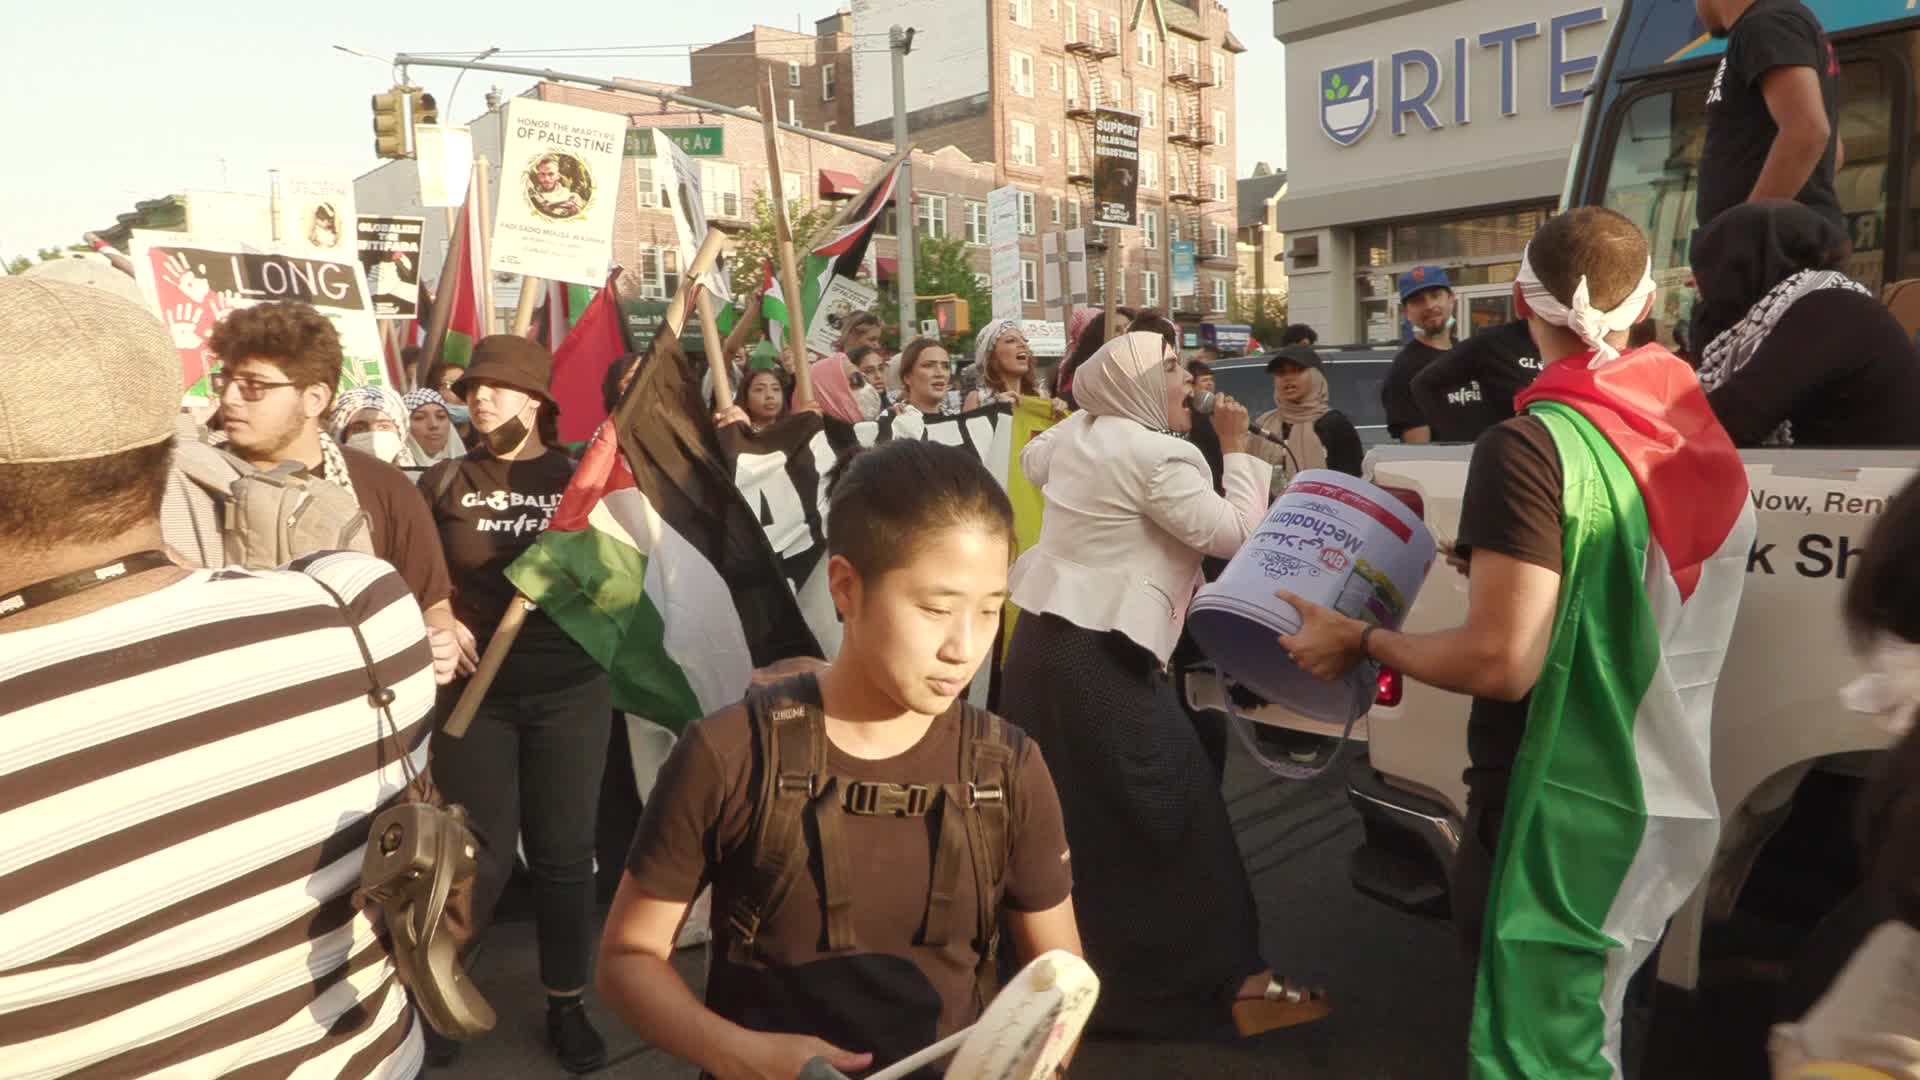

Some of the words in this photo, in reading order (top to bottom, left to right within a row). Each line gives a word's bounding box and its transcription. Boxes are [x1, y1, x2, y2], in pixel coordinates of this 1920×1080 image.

[1391, 6, 1608, 136] RITE
[516, 126, 536, 140] OF
[538, 129, 614, 154] PALESTINE
[517, 117, 551, 129] HONOR
[552, 122, 570, 133] THE
[571, 126, 616, 141] MARTYRS
[693, 133, 713, 150] Av
[1096, 119, 1138, 138] SUPPORT
[231, 255, 350, 300] LONG
[1749, 489, 1812, 516] Now,
[1824, 491, 1891, 514] Ren
[1271, 511, 1364, 555] Mechaalan
[1322, 550, 1347, 569] BM
